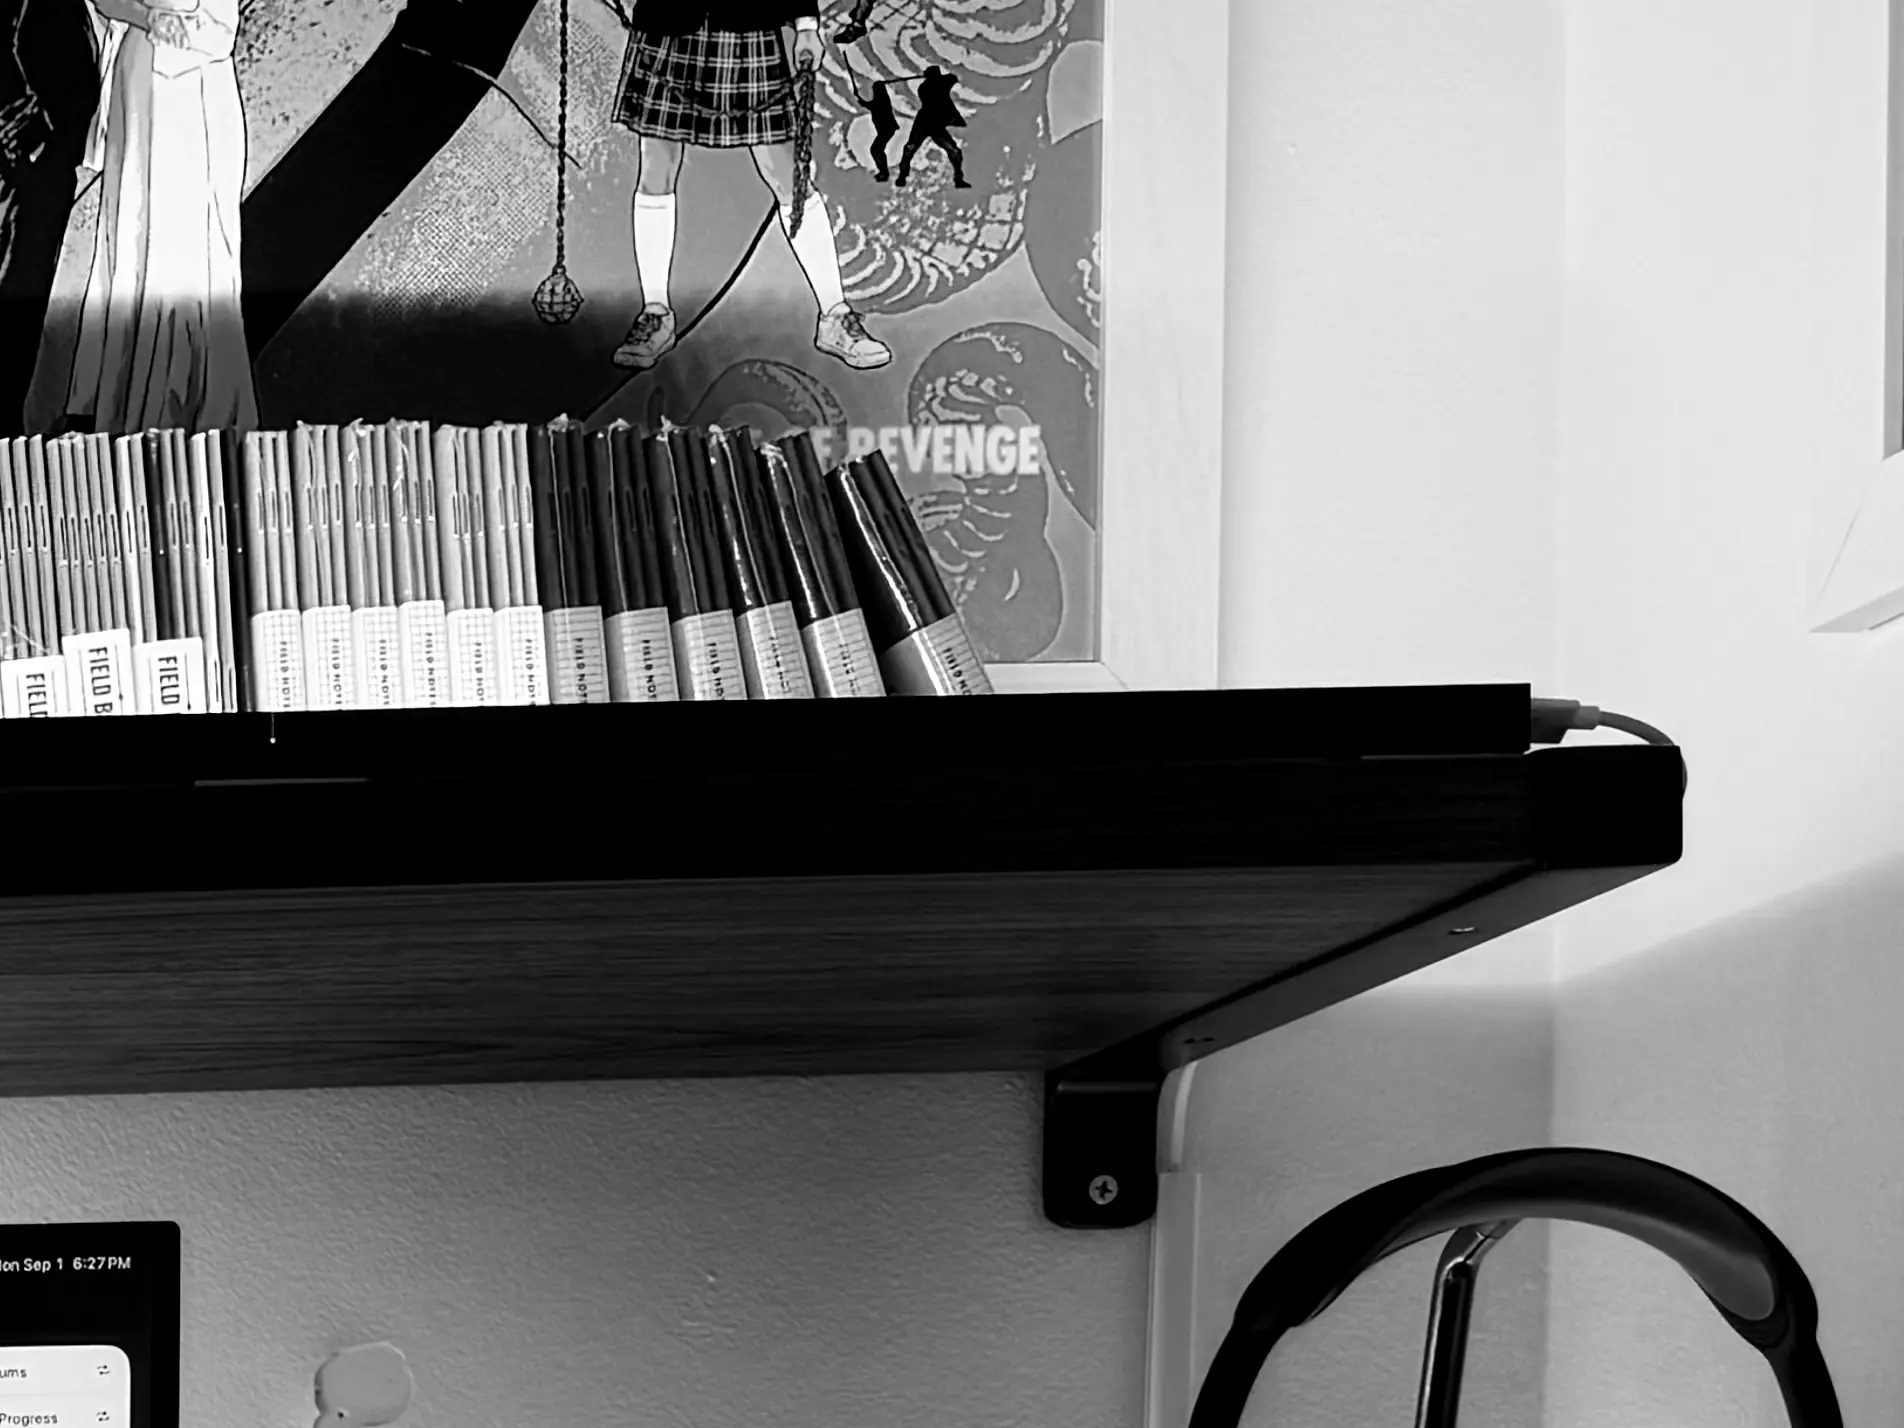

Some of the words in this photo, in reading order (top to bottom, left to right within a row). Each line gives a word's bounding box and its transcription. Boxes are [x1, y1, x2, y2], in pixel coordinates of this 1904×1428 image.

[89, 646, 112, 697] FIELD
[158, 656, 181, 706] FIELD
[23, 1257, 52, 1275] Sep
